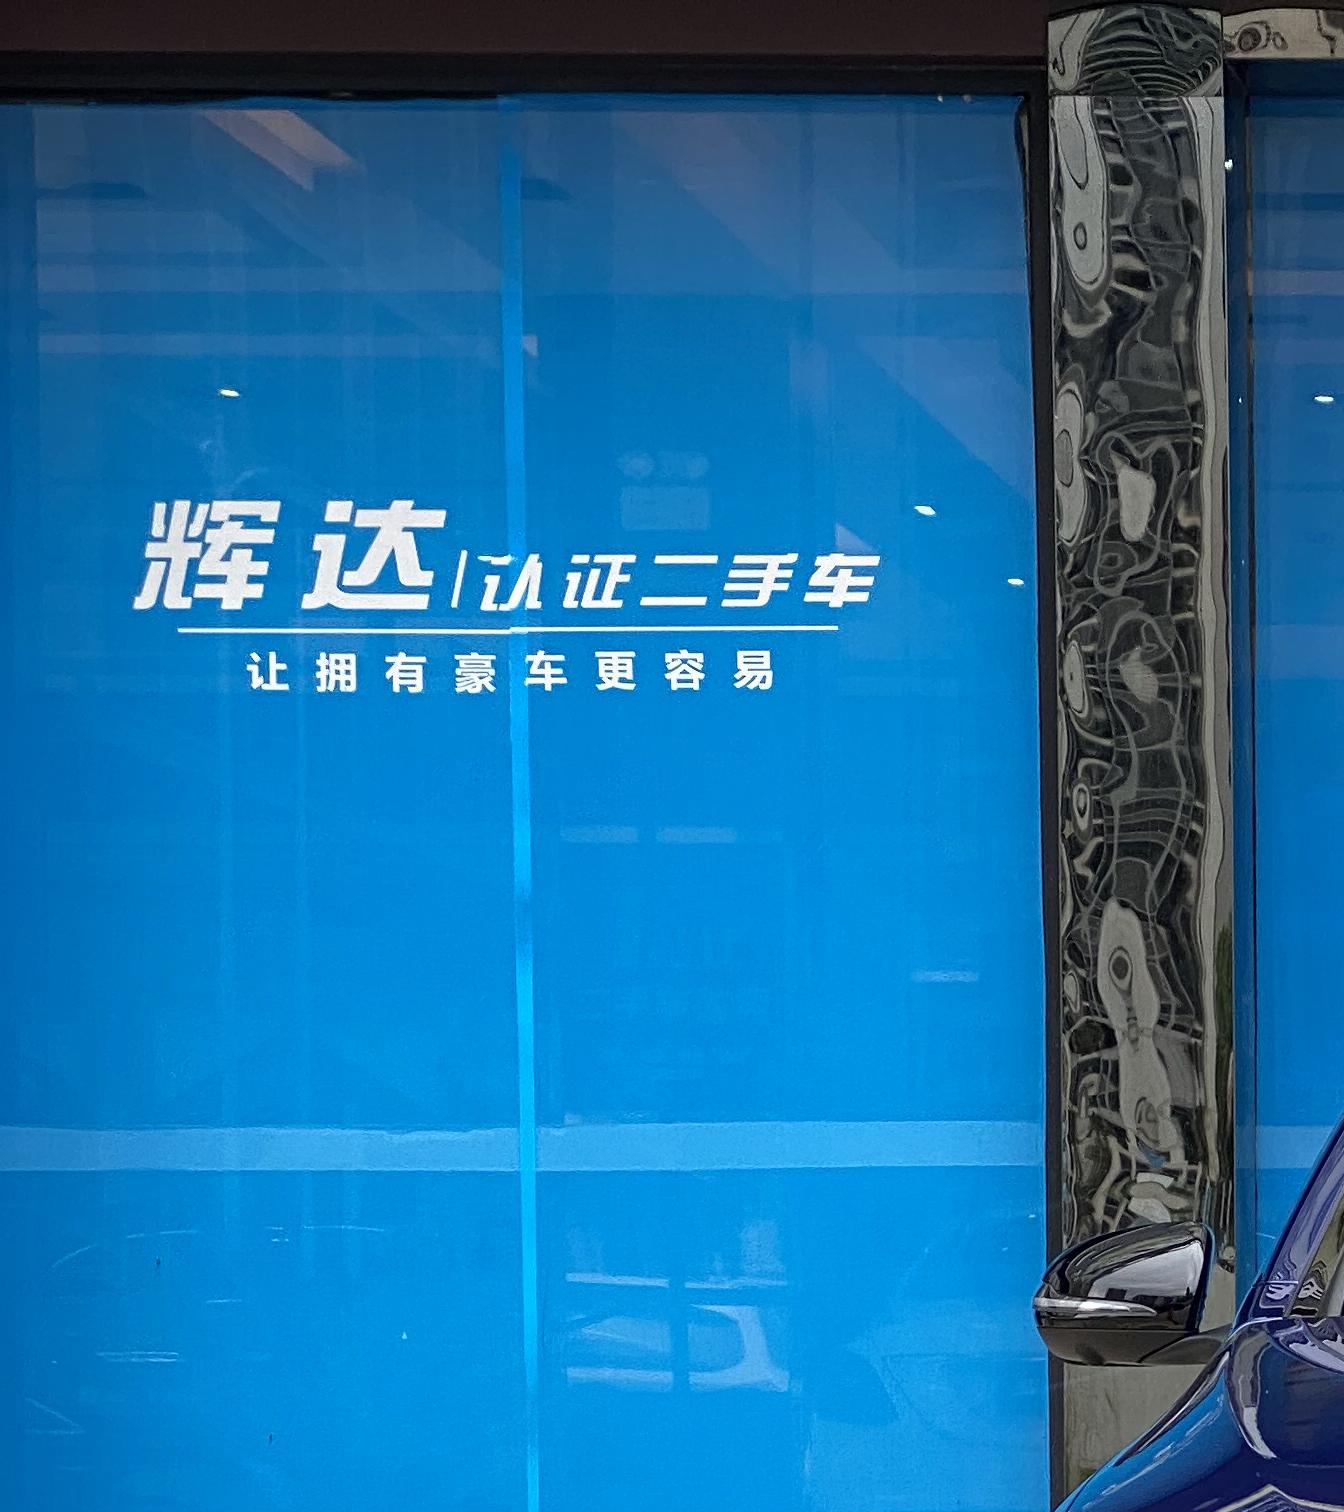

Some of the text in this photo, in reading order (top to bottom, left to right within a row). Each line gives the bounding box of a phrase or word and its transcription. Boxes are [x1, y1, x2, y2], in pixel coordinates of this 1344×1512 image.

[134, 500, 880, 611] 辉达 认证二手车
[247, 650, 774, 693] 让拥有豪车更容易
